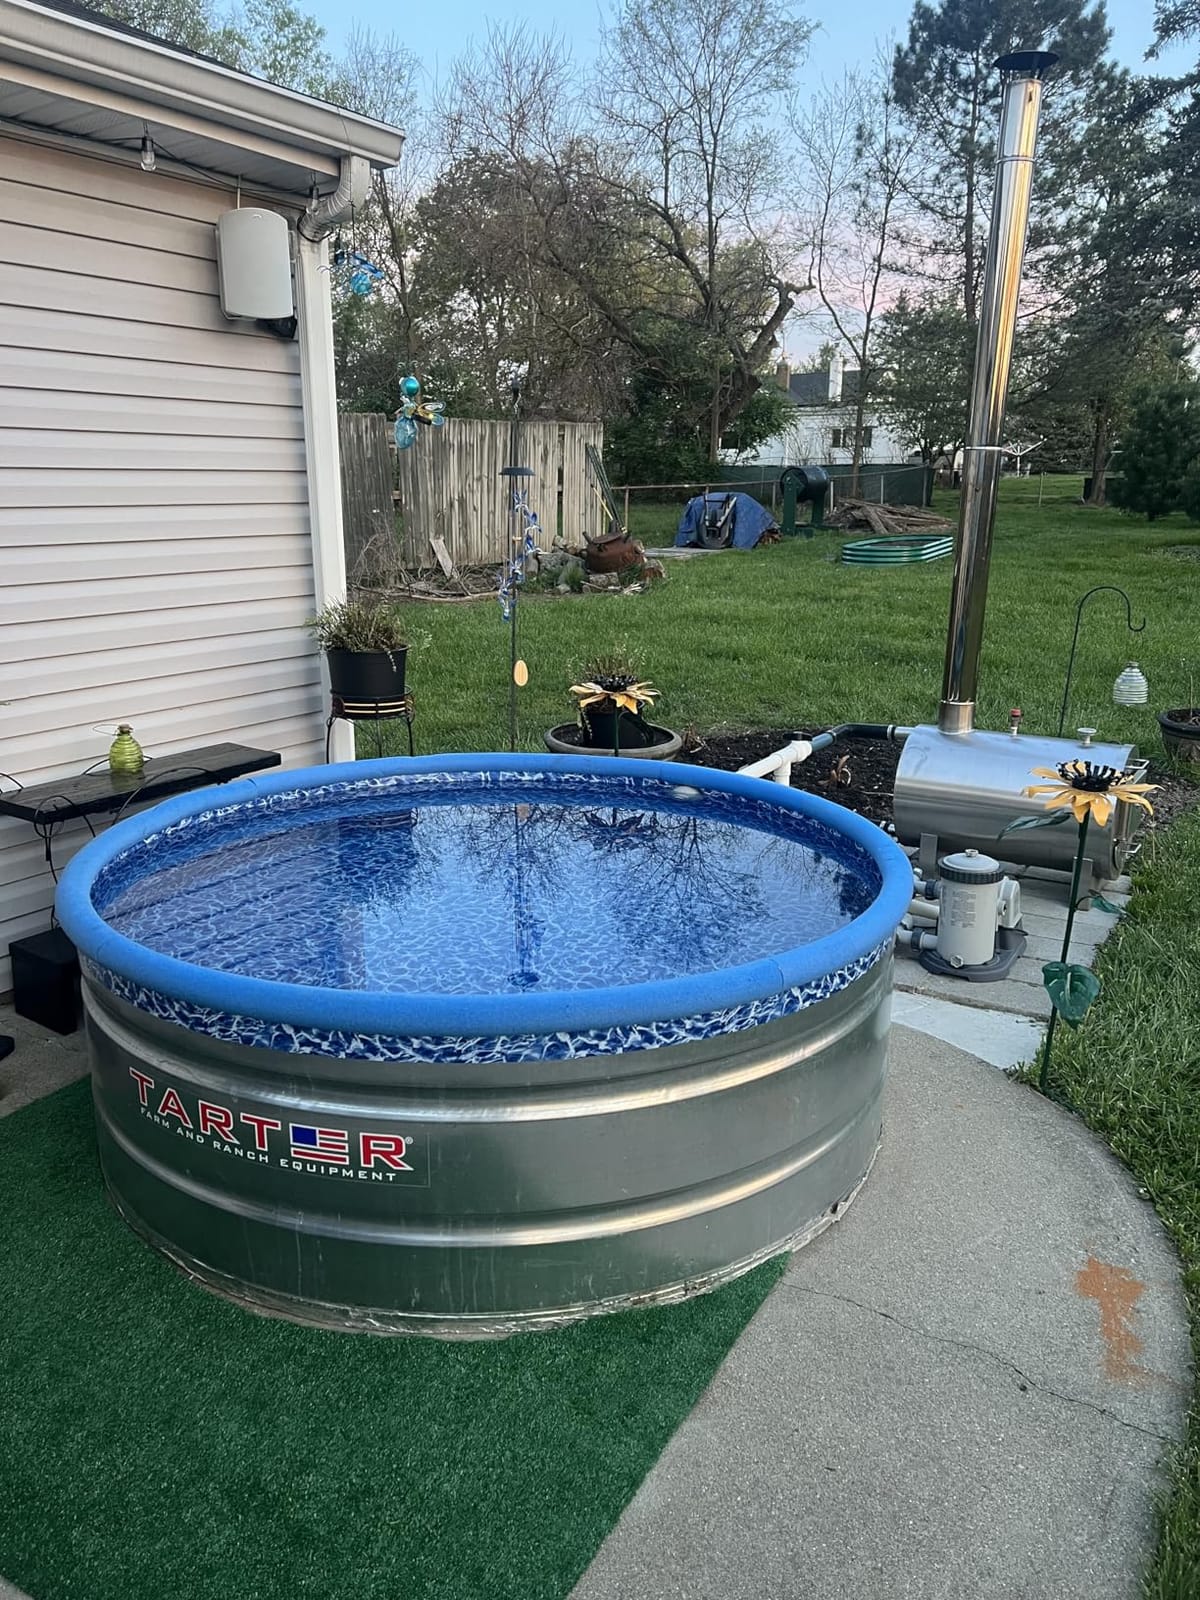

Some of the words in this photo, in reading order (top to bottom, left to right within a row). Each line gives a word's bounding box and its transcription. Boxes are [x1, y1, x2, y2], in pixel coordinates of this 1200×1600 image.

[140, 1107, 170, 1129] FARM
[176, 1126, 205, 1144] AND
[213, 1140, 269, 1163] RANCH
[279, 1158, 397, 1182] EQUIPMENT
